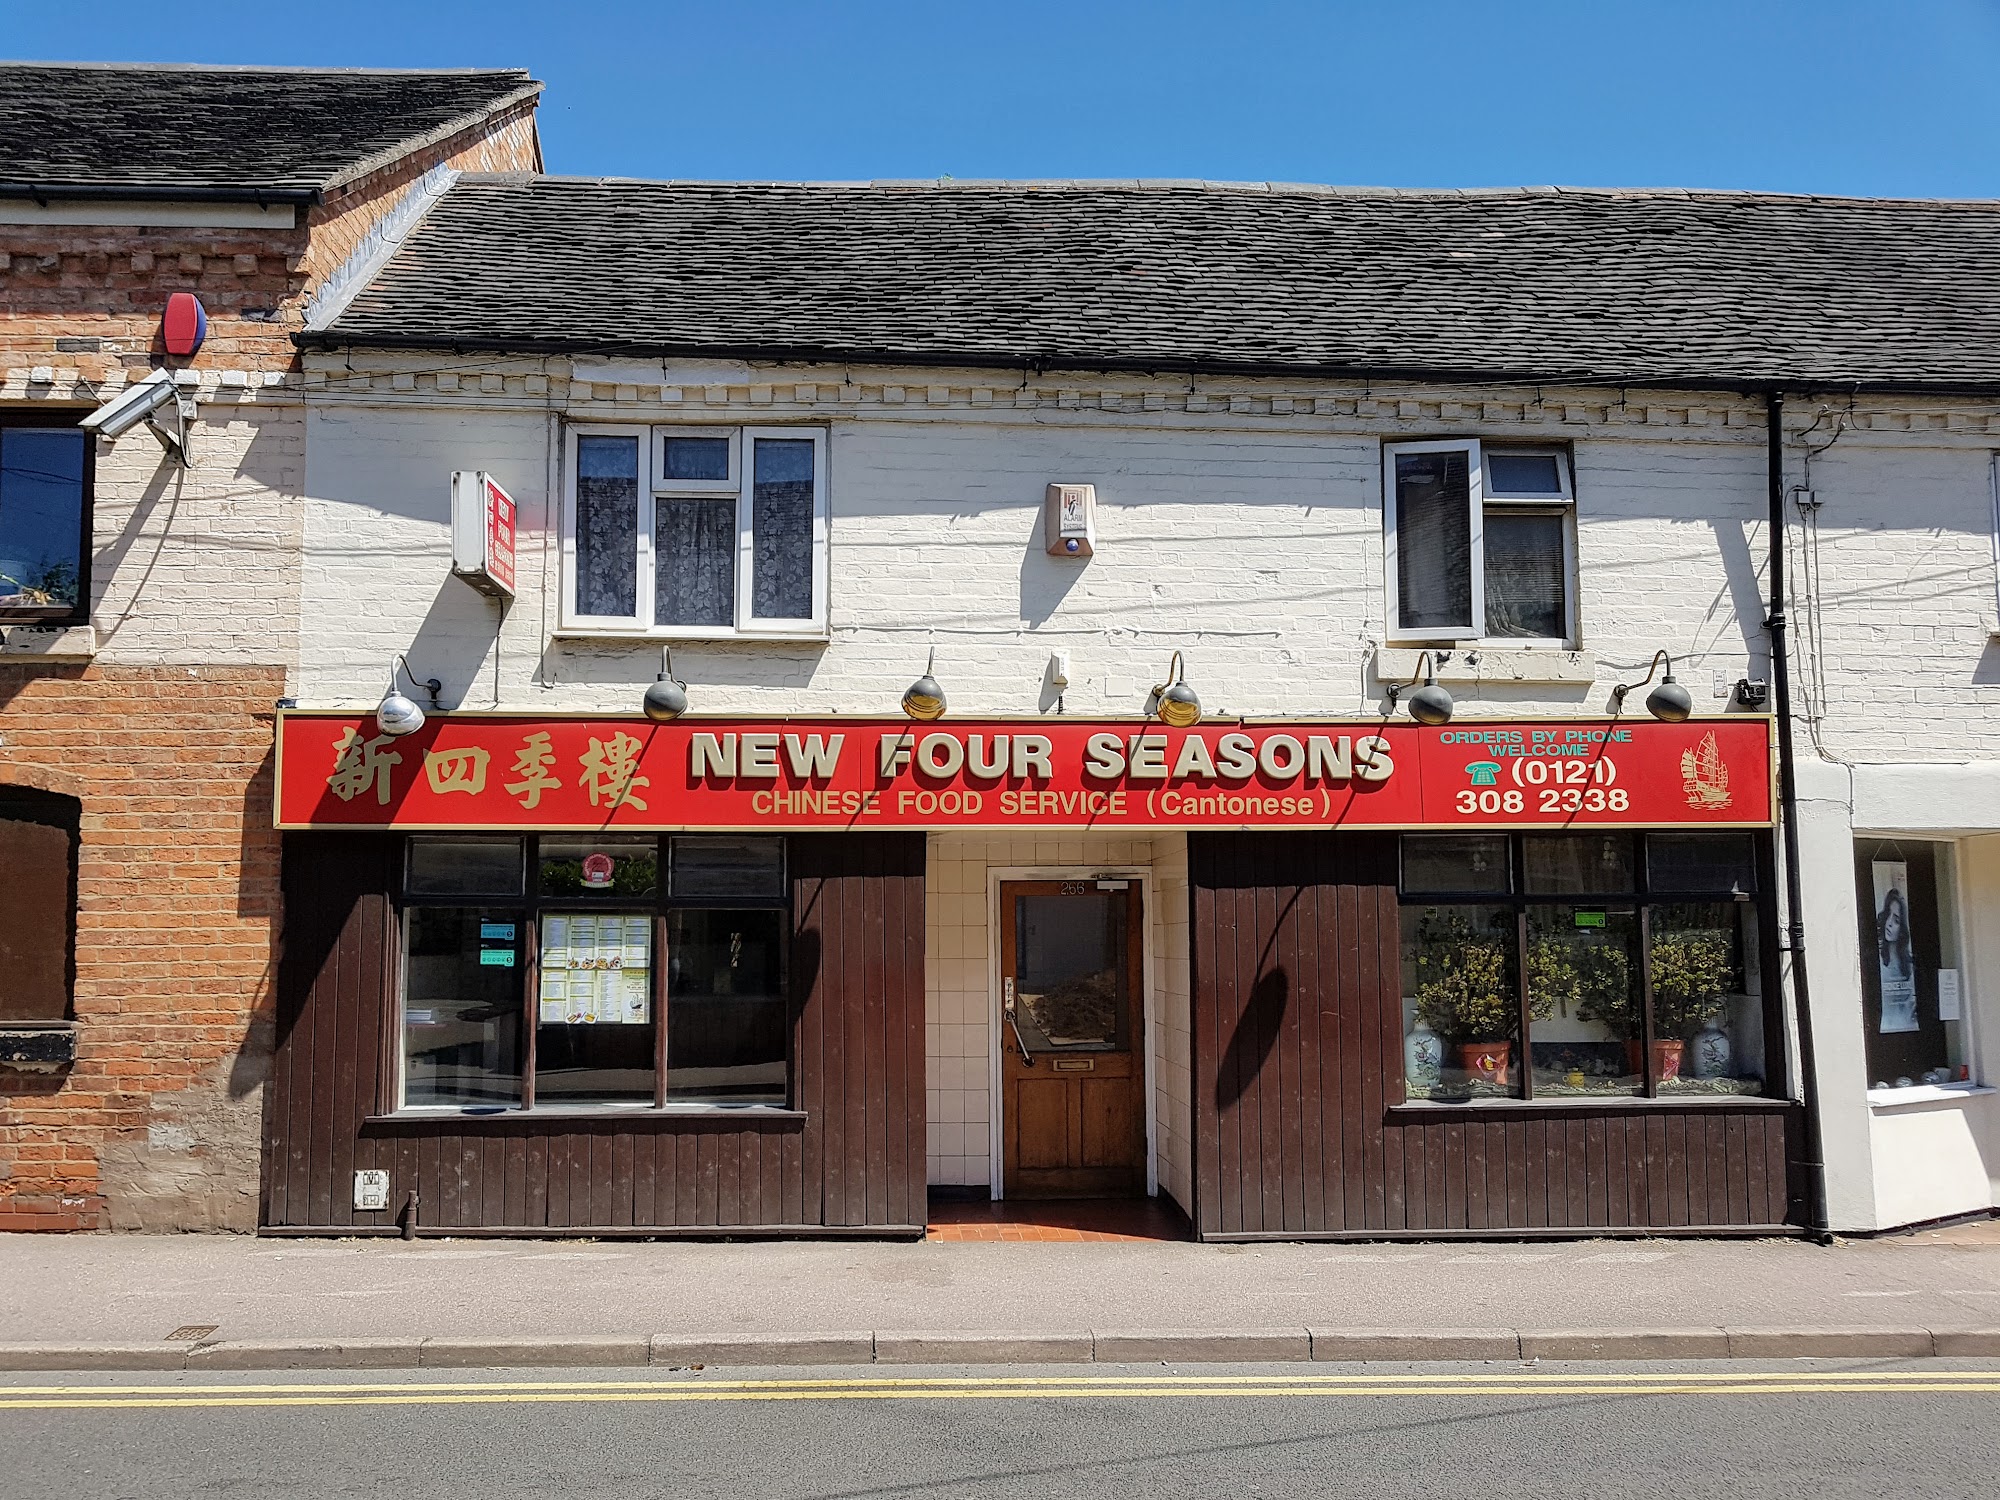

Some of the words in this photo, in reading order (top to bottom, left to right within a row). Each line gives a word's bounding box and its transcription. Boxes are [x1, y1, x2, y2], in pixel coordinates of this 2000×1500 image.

[1440, 731, 1523, 744] ORDERS
[1532, 731, 1556, 743] BY
[1565, 730, 1633, 742] PHONE
[1488, 744, 1590, 756] WELCOME
[691, 733, 846, 779] NEW
[880, 733, 1053, 780] FOUR
[1085, 733, 1395, 782] SEASONS
[1512, 757, 1616, 787] (0121)
[752, 790, 880, 815] CHINESE
[898, 790, 983, 815] FOOD
[1000, 790, 1127, 816] SERVICE
[1456, 790, 1525, 814] 308
[1539, 788, 1630, 813] 2338
